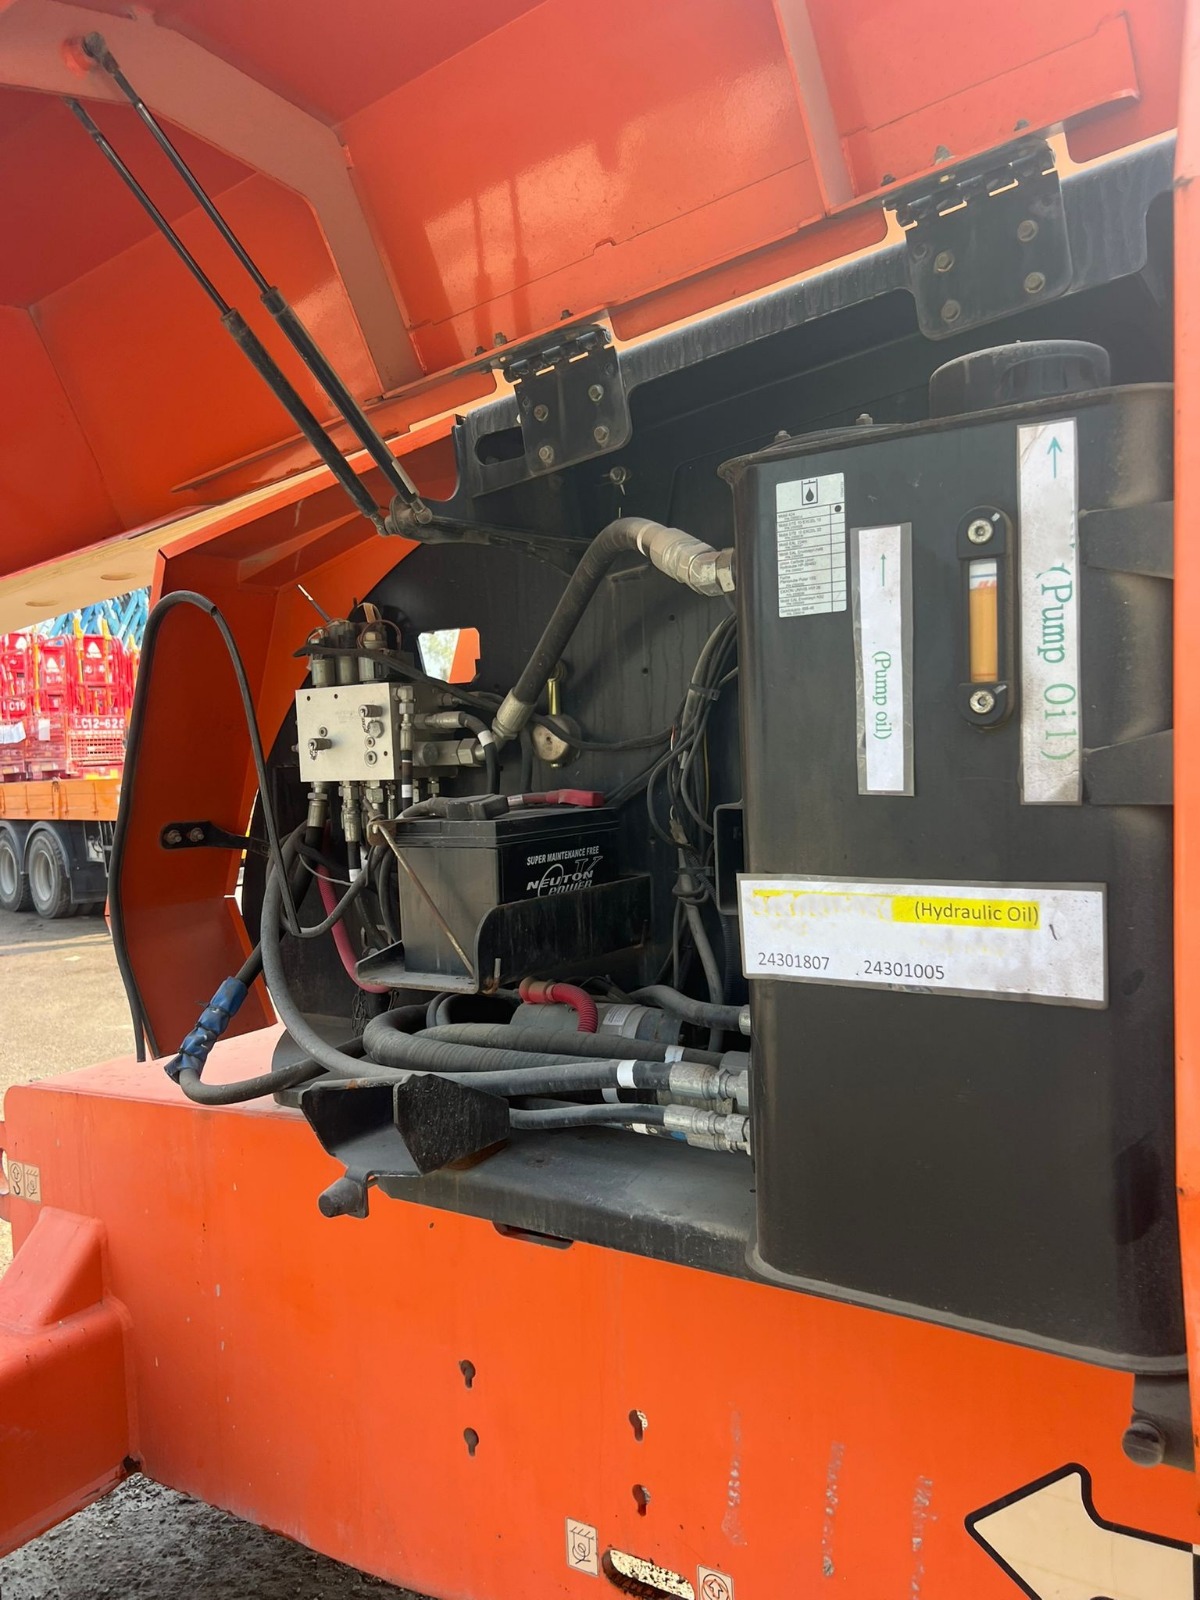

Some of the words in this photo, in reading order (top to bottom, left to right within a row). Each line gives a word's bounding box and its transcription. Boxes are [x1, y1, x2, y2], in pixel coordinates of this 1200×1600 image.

[1036, 562, 1073, 665] (Pump
[874, 649, 892, 707] (Pump
[874, 711, 892, 741] oil)
[1039, 682, 1077, 761] Oil)
[526, 854, 547, 866] SUPER
[546, 847, 586, 862] MAINTENANCE
[586, 845, 600, 855] FREE
[914, 901, 1002, 923] (Hydraulic
[1006, 905, 1040, 926] Oil)
[757, 951, 830, 971] 24301807
[863, 959, 945, 980] 24301005
